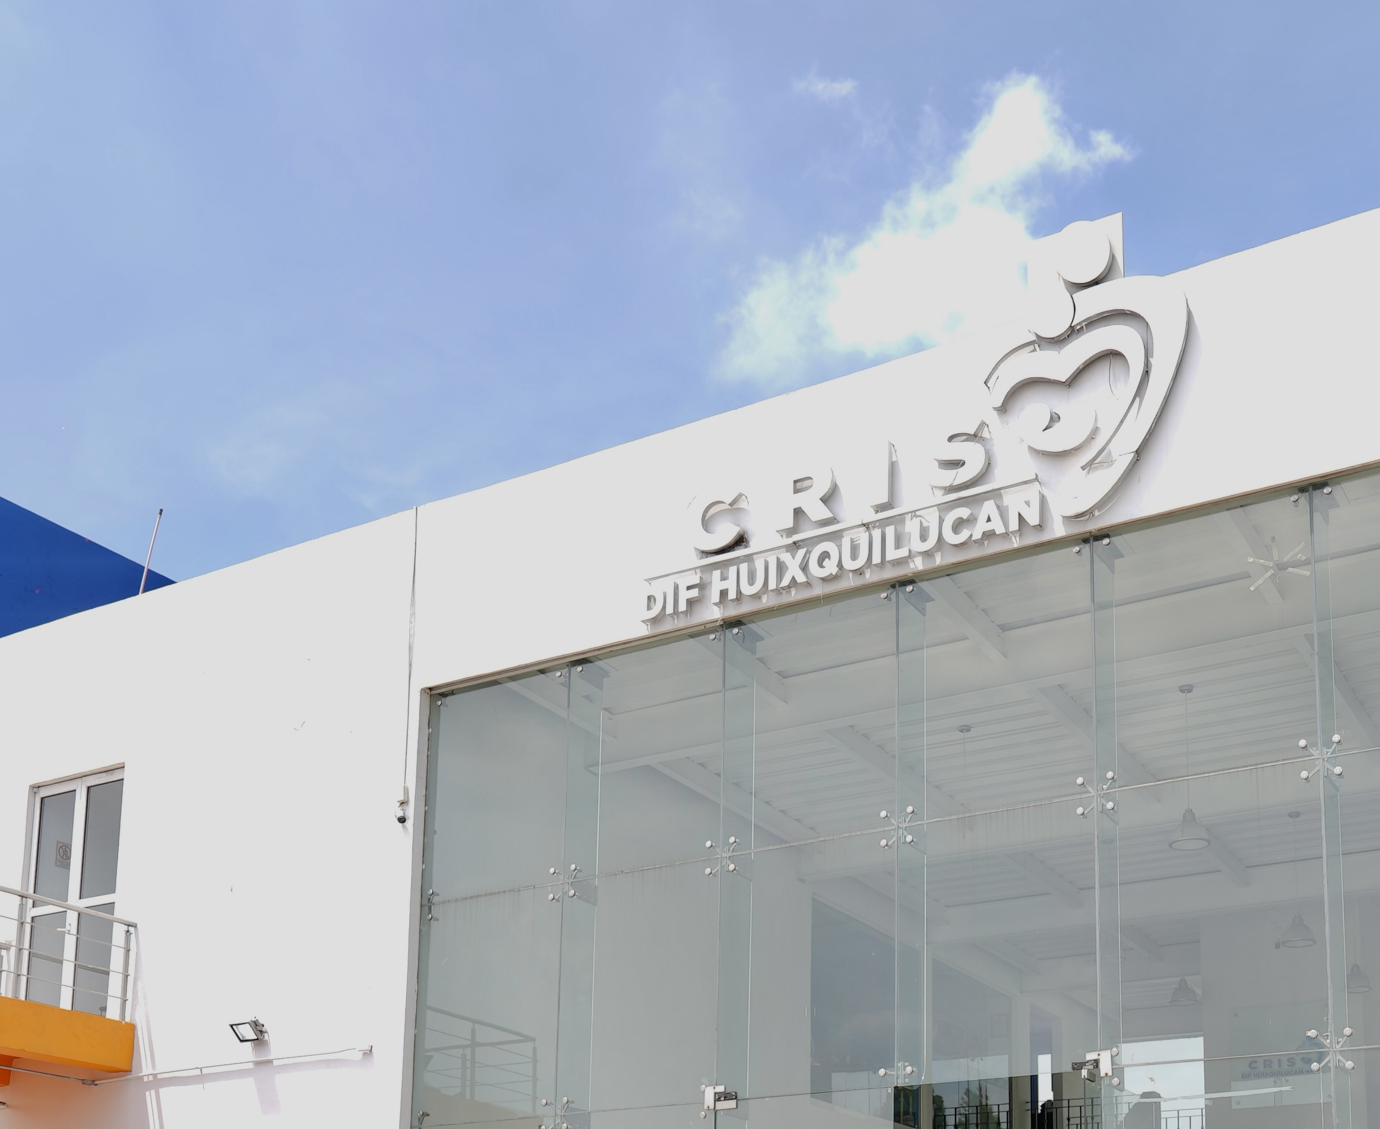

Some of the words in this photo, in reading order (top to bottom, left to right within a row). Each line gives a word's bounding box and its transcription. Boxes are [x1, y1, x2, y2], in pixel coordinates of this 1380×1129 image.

[689, 419, 991, 553] CRIS
[640, 572, 701, 622] DIF
[711, 489, 1044, 605] HUIXQUILUCAN
[1248, 1057, 1296, 1070] CRIS
